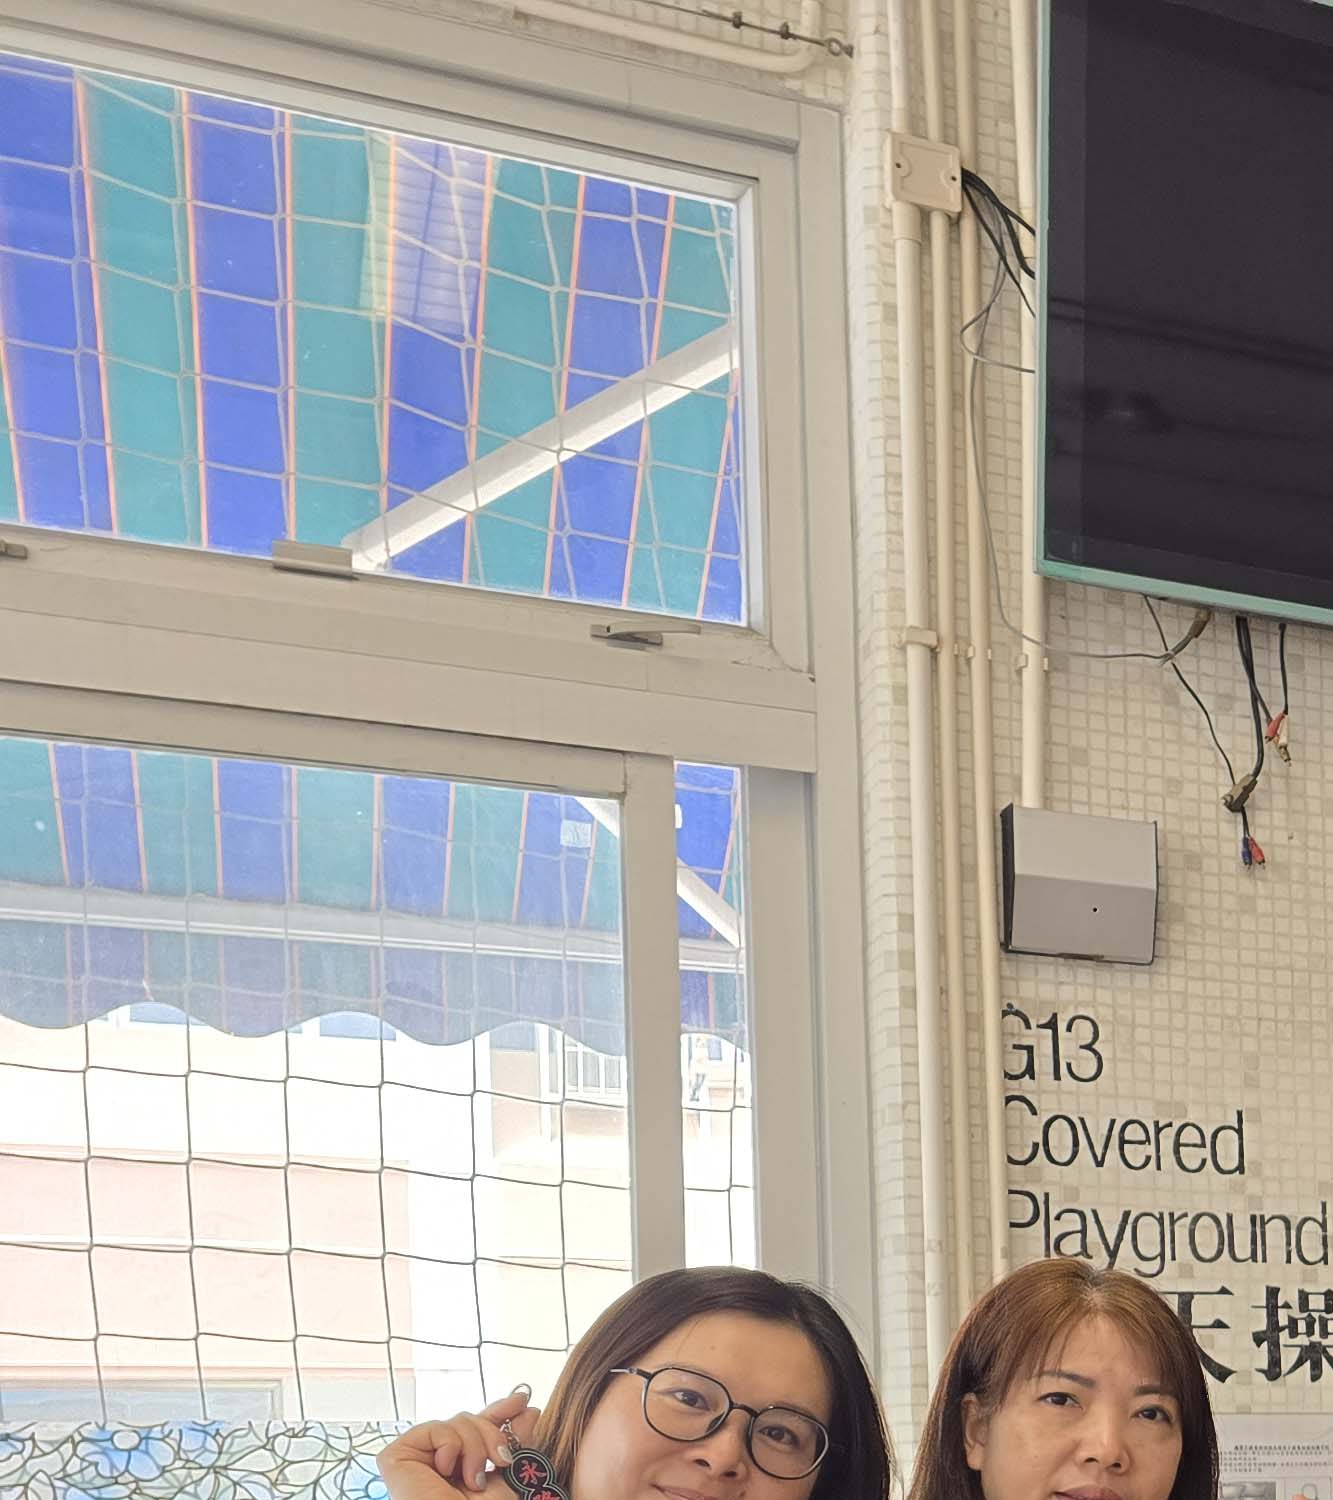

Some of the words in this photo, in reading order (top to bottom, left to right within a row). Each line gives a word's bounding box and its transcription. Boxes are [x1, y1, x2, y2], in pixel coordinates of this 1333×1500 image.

[1001, 1008, 1103, 1083] G13
[1005, 1095, 1247, 1176] Covered
[1008, 1190, 1330, 1278] Playground
